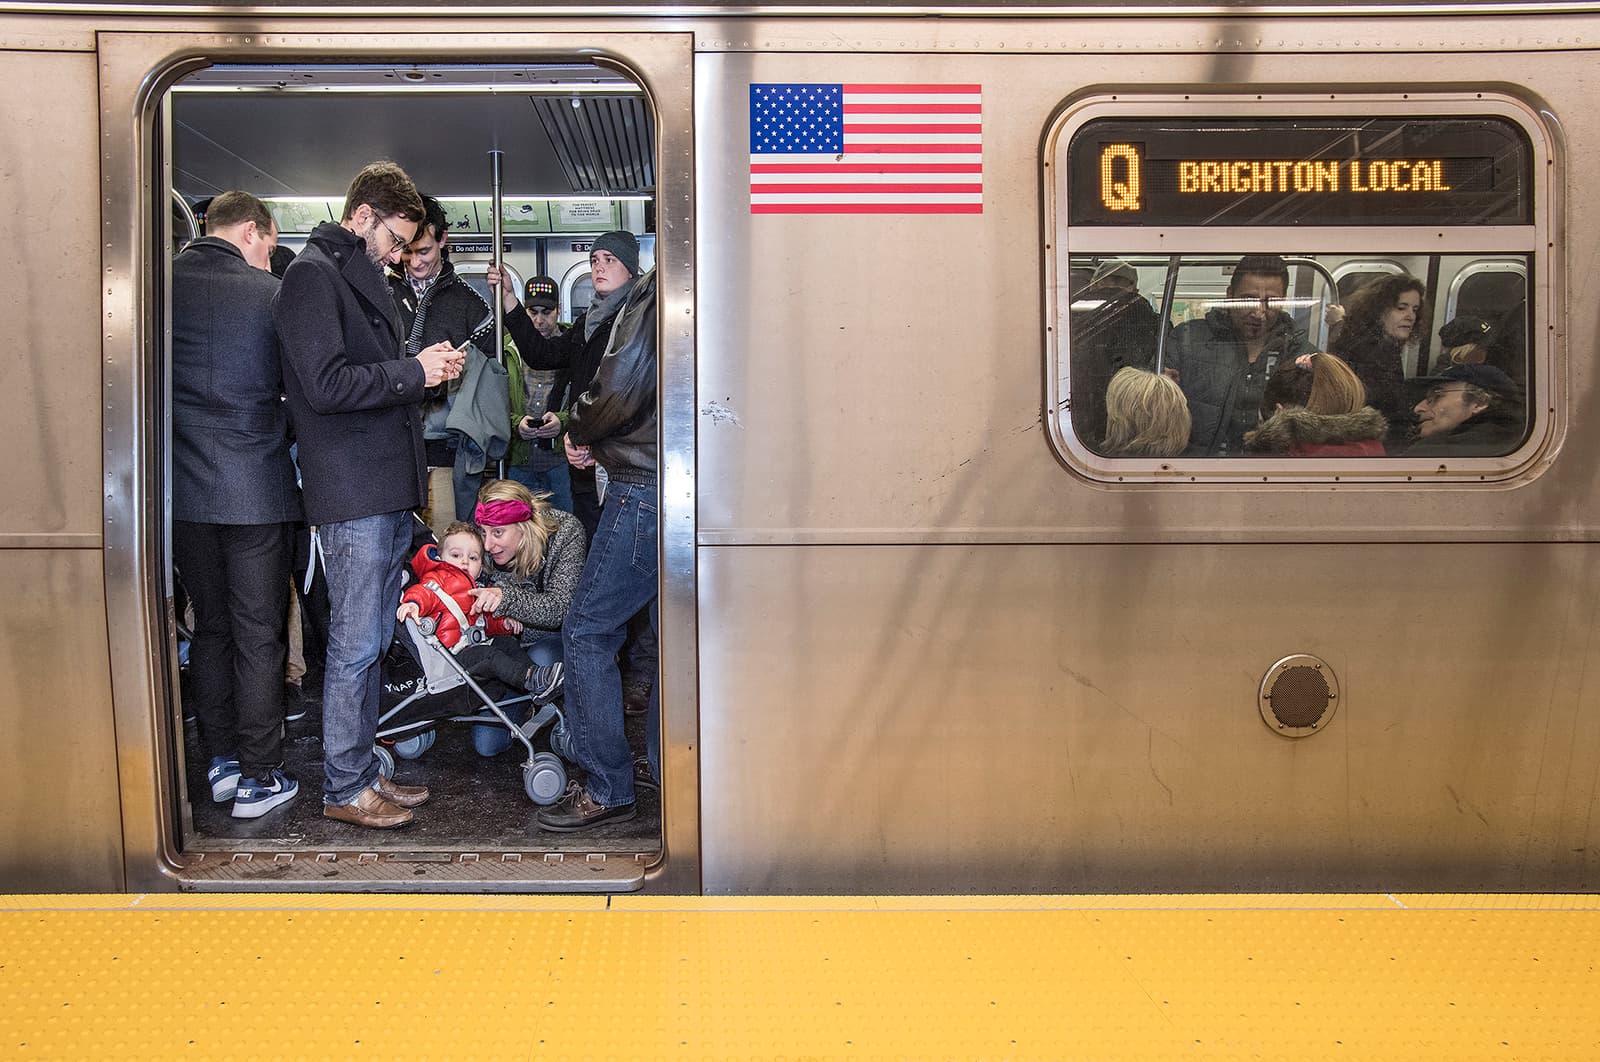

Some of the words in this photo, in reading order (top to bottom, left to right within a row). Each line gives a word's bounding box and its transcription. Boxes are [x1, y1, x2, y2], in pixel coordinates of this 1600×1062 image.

[1101, 144, 1140, 210] Q
[1179, 161, 1339, 192] BRIGHTON
[1351, 160, 1450, 192] LOCAL
